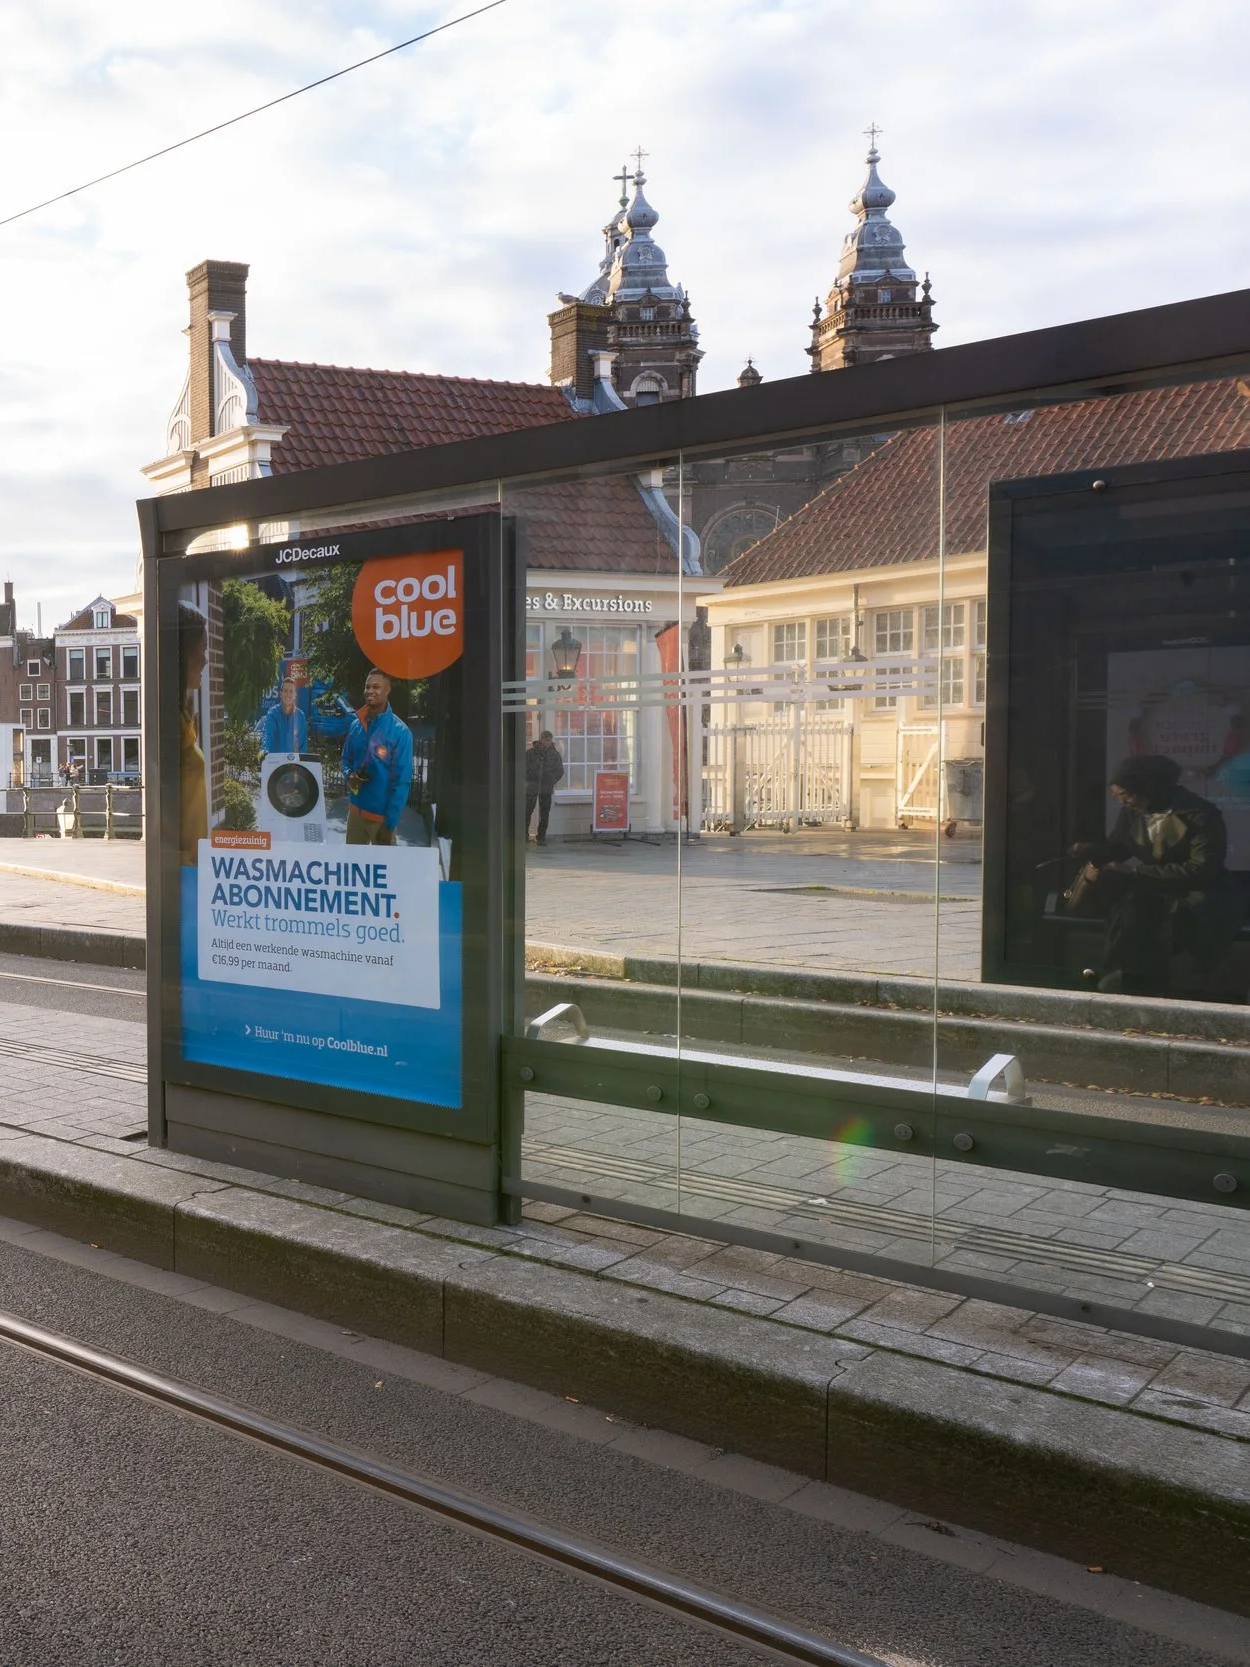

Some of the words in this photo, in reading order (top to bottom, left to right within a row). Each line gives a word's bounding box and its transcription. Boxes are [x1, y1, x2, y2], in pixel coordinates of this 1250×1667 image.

[275, 544, 340, 564] JCDecaux
[374, 564, 456, 605] cool
[544, 592, 559, 610] &
[562, 593, 653, 612] Excursions
[375, 605, 457, 641] blue
[214, 835, 267, 847] energiezuinig
[210, 856, 388, 889] WASMACHINE
[210, 882, 400, 919] ABONNEMENT.
[211, 908, 261, 930] Werkt
[265, 914, 351, 938] trommels
[356, 923, 405, 945] goed.
[211, 938, 234, 951] Altijd
[235, 943, 252, 951] een
[254, 943, 299, 956] werkende
[301, 949, 362, 963] wasmachine
[365, 955, 395, 966] vanaf
[212, 954, 240, 967] €16,99
[241, 960, 256, 972] per
[258, 960, 293, 973] maand.
[254, 1025, 279, 1040] Huur
[282, 1030, 294, 1042] 'm
[296, 1034, 310, 1045] nu
[312, 1036, 325, 1049] op
[327, 1037, 388, 1057] Coolblue.nl
